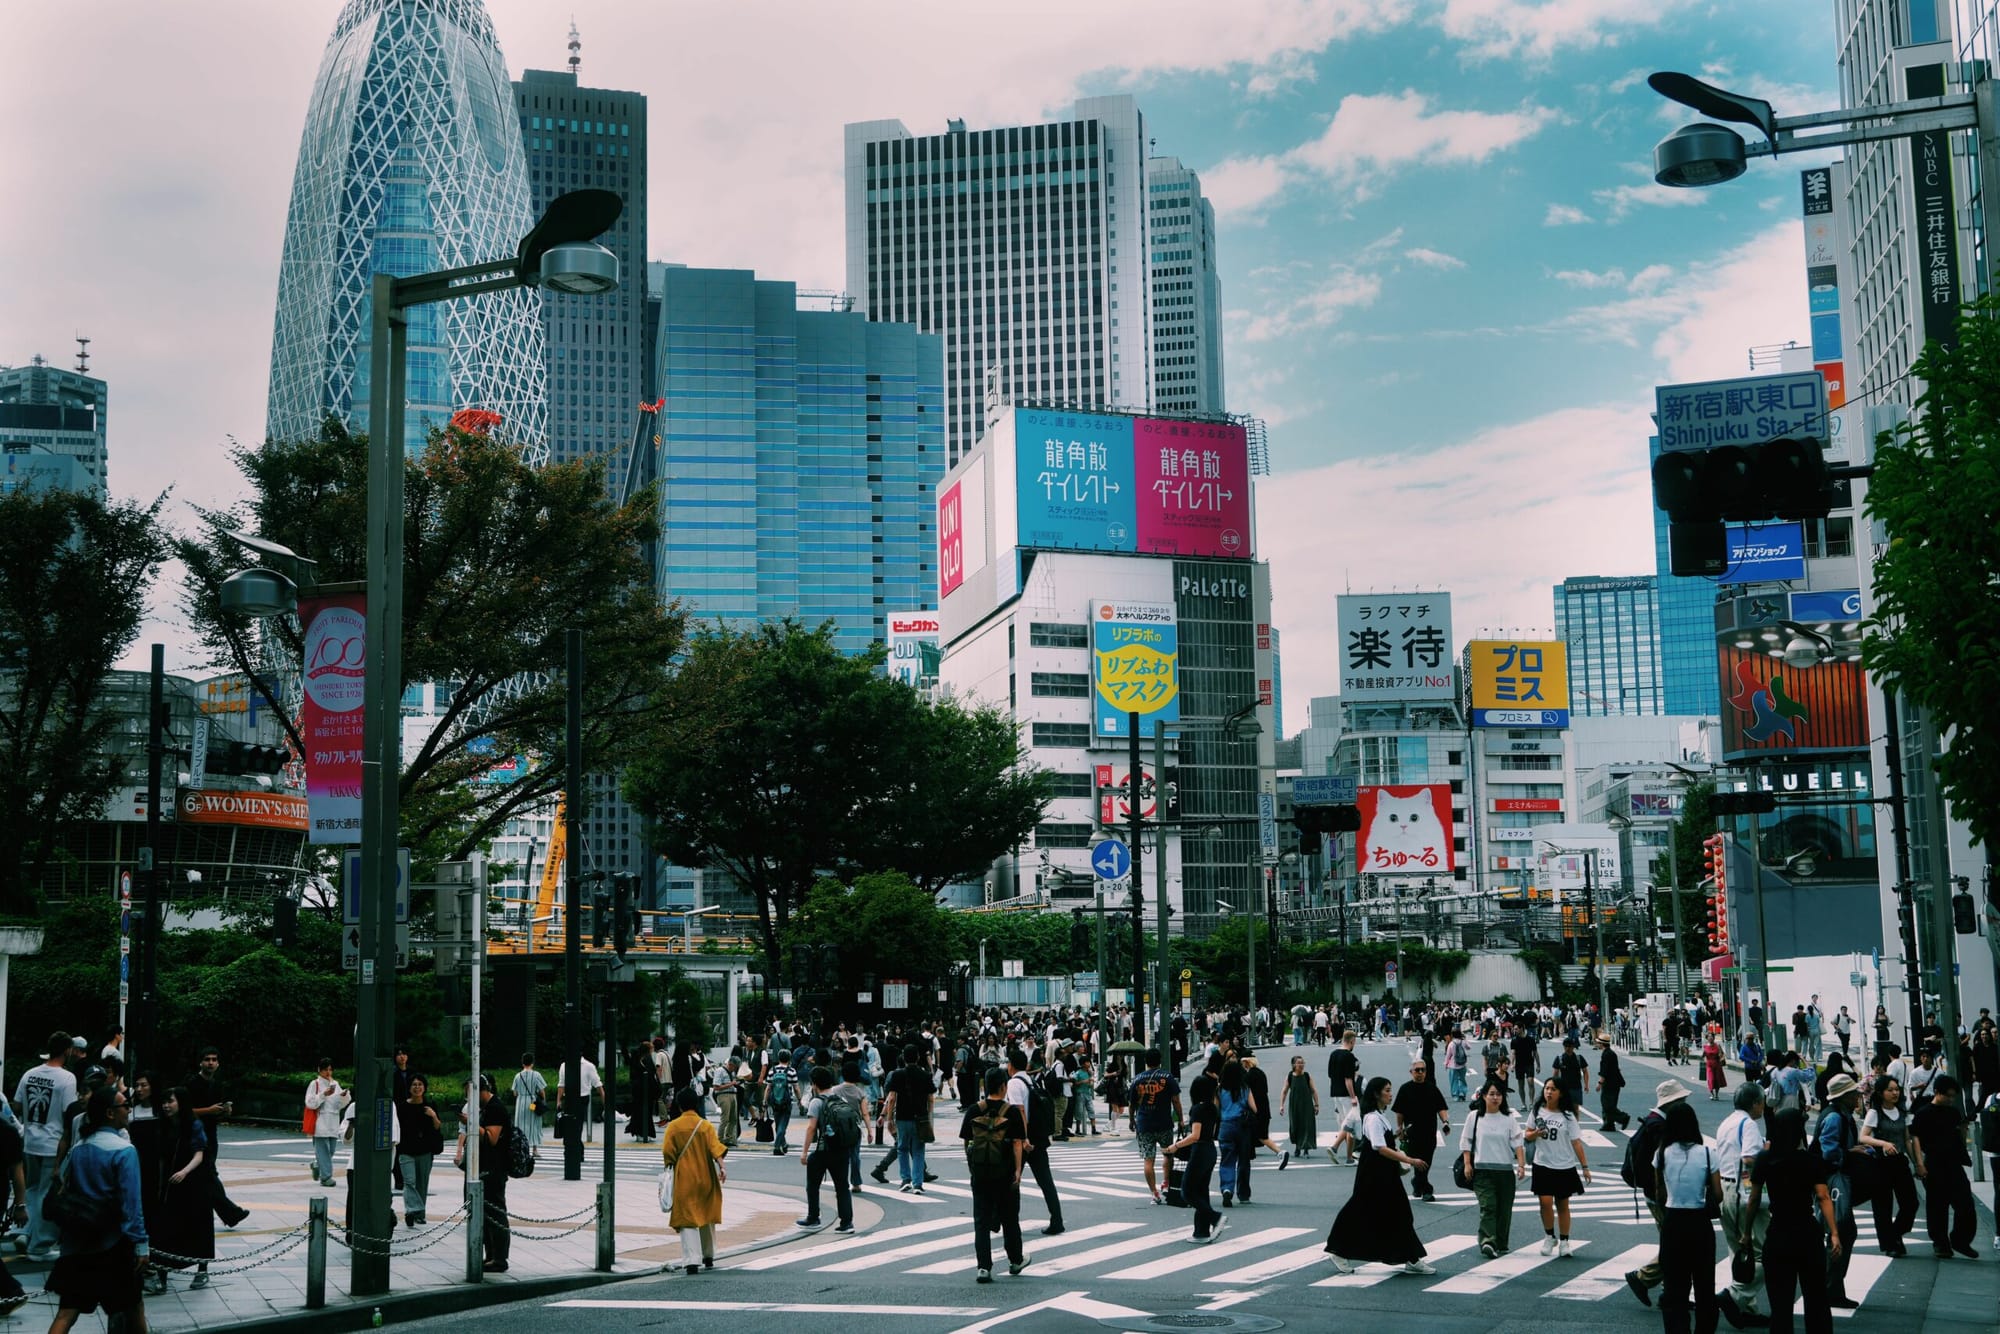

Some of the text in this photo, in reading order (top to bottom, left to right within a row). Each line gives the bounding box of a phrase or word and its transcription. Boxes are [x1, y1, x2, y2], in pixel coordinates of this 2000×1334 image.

[1925, 195, 1952, 304] 三井住友銀行
[1664, 382, 1818, 423] 新宿駅東口
[1664, 420, 1749, 447] Shinjuku
[1045, 438, 1107, 471] 龍角散
[1160, 447, 1220, 479] 龍角散
[1037, 471, 1120, 504] ダイレクト
[1153, 479, 1233, 511] ダイレクト
[942, 496, 958, 540] UNI
[943, 537, 960, 587] QLO
[1359, 605, 1431, 620] ラクマチ
[1347, 625, 1445, 670] 楽待
[1492, 644, 1543, 673] プロ
[1108, 655, 1170, 676] リブふわ
[321, 690, 344, 699] SINCE
[1106, 679, 1169, 702] マスク
[1345, 676, 1424, 690] 不動産投資アプリ
[1495, 677, 1545, 701] ミス
[1499, 713, 1533, 722] プロミス
[1295, 779, 1353, 791] 新宿駅東口
[1295, 791, 1328, 802] Shinjuku
[205, 795, 282, 817] WOMEN'S
